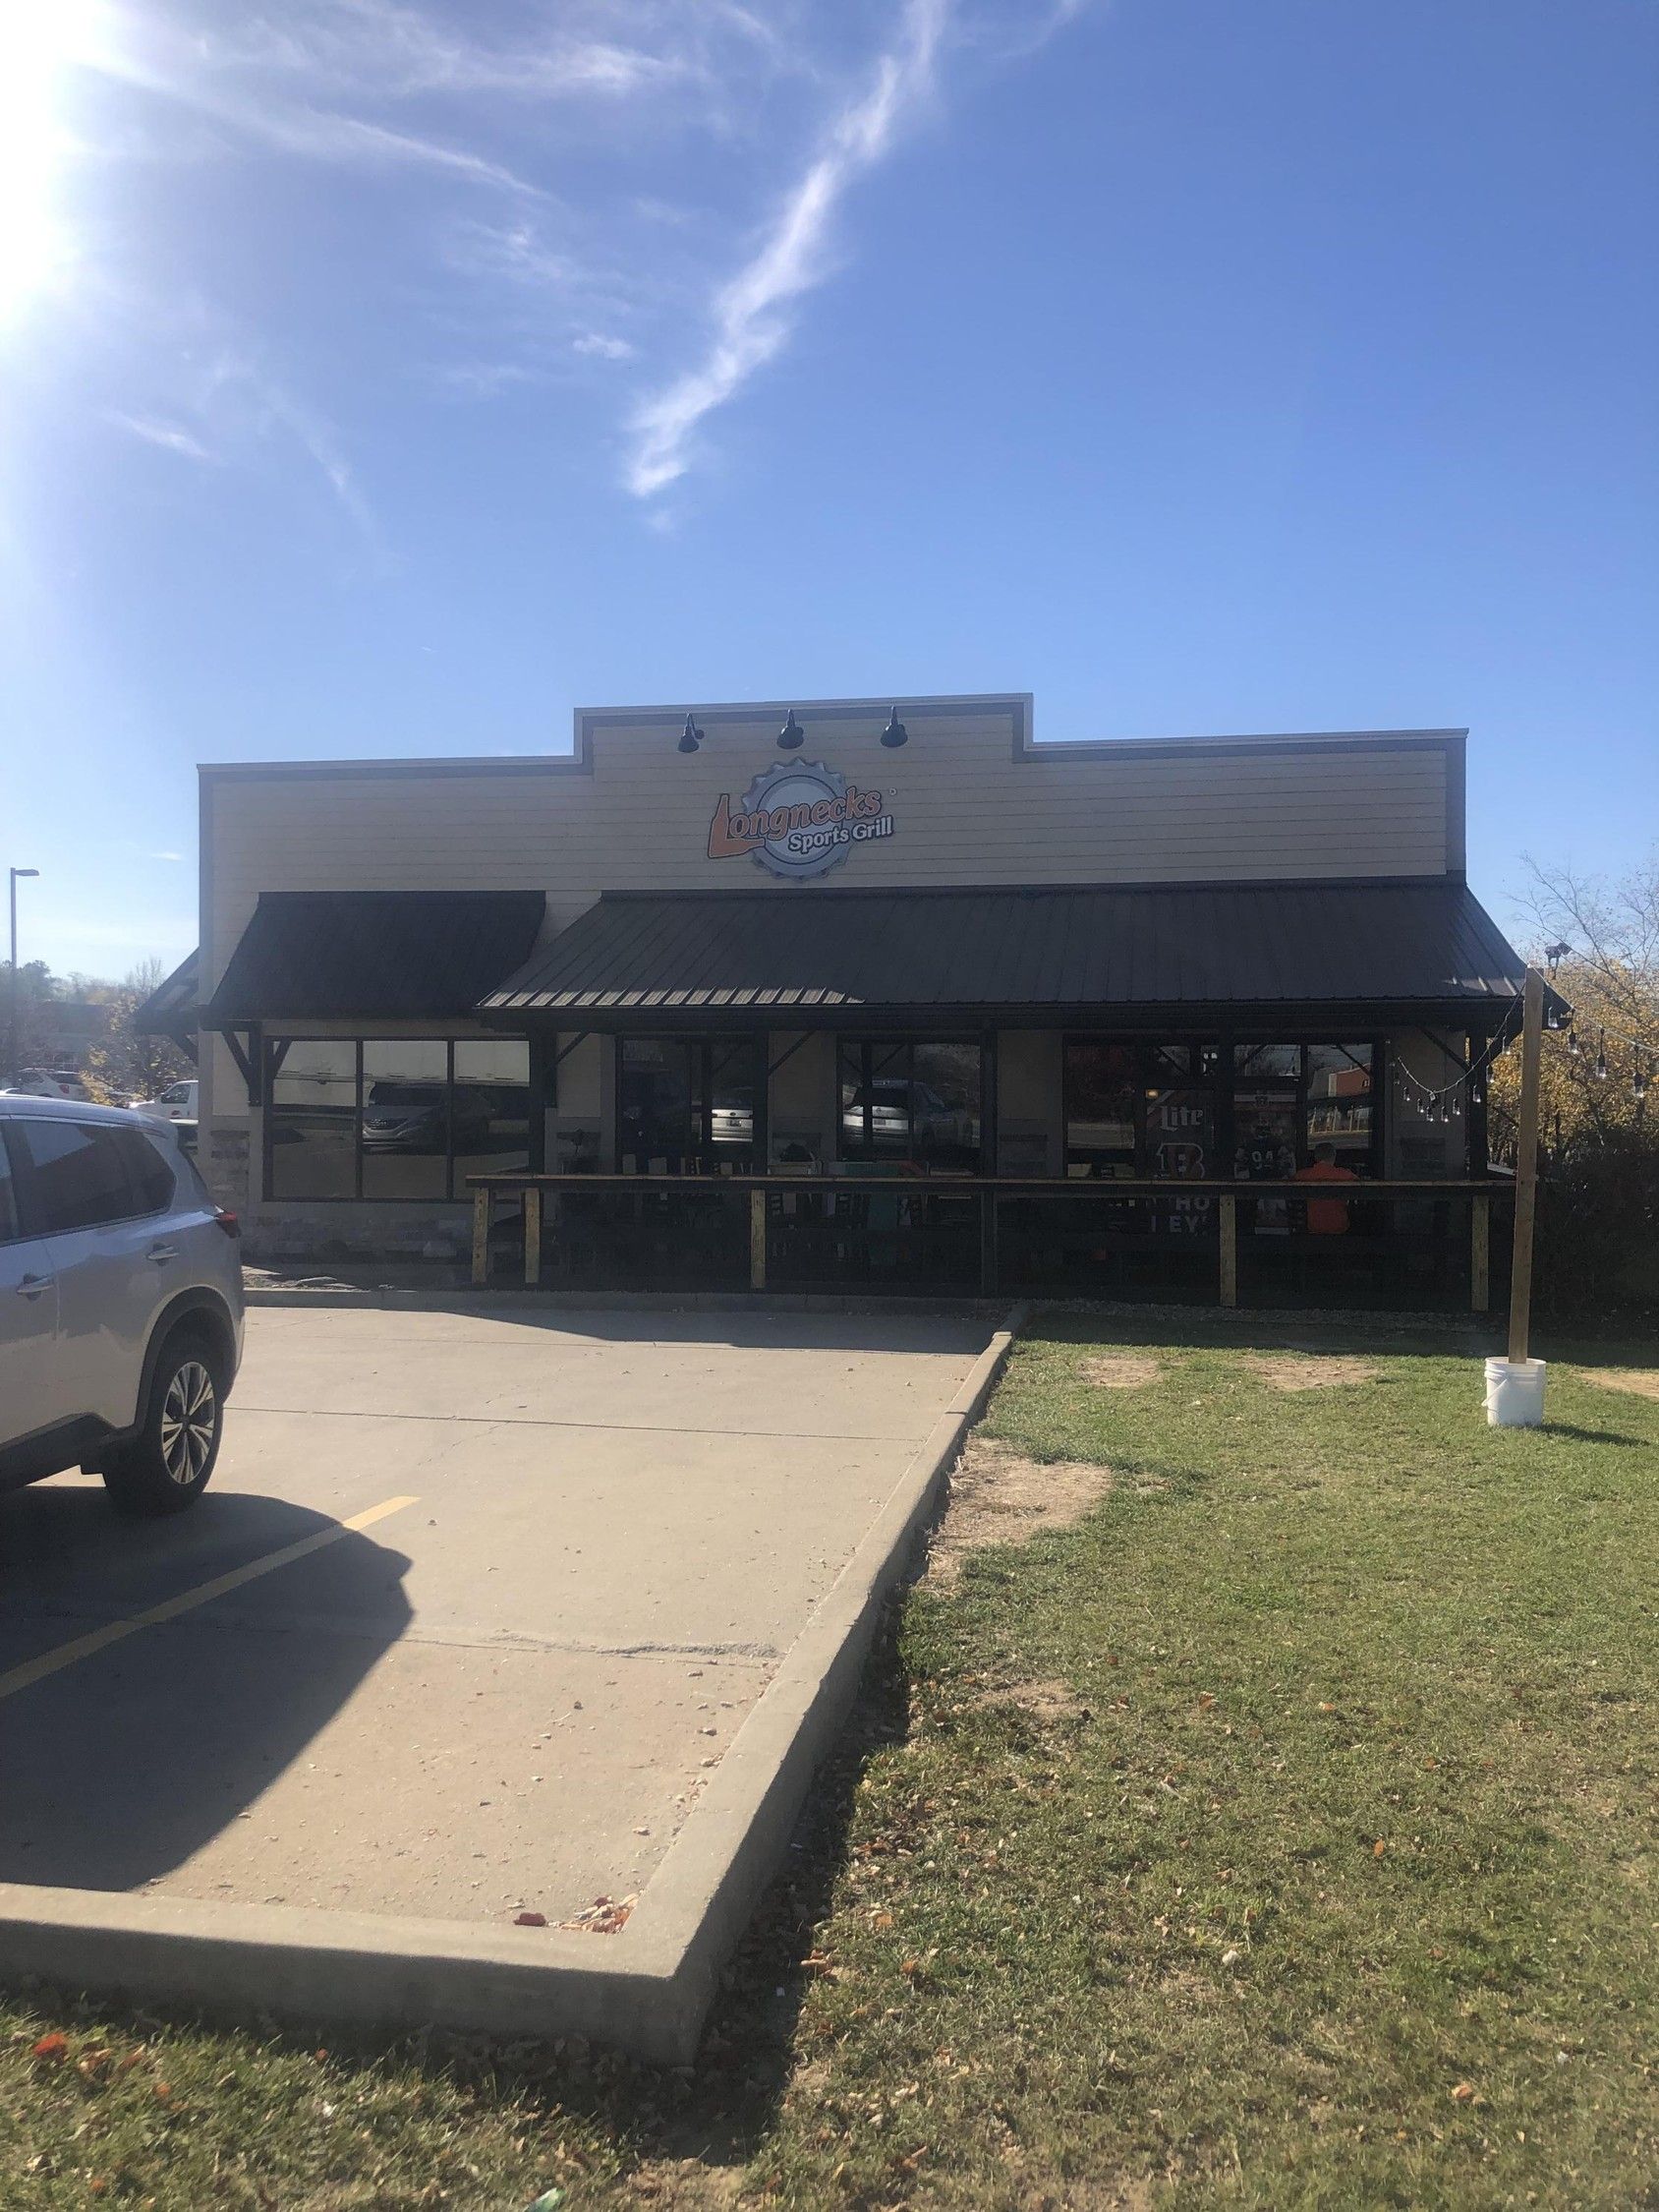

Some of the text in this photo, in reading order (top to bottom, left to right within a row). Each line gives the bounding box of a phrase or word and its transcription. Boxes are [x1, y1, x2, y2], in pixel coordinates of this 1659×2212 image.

[708, 786, 883, 858] Longnecks
[788, 815, 893, 853] Sports Grill
[1159, 1106, 1204, 1132] Lite
